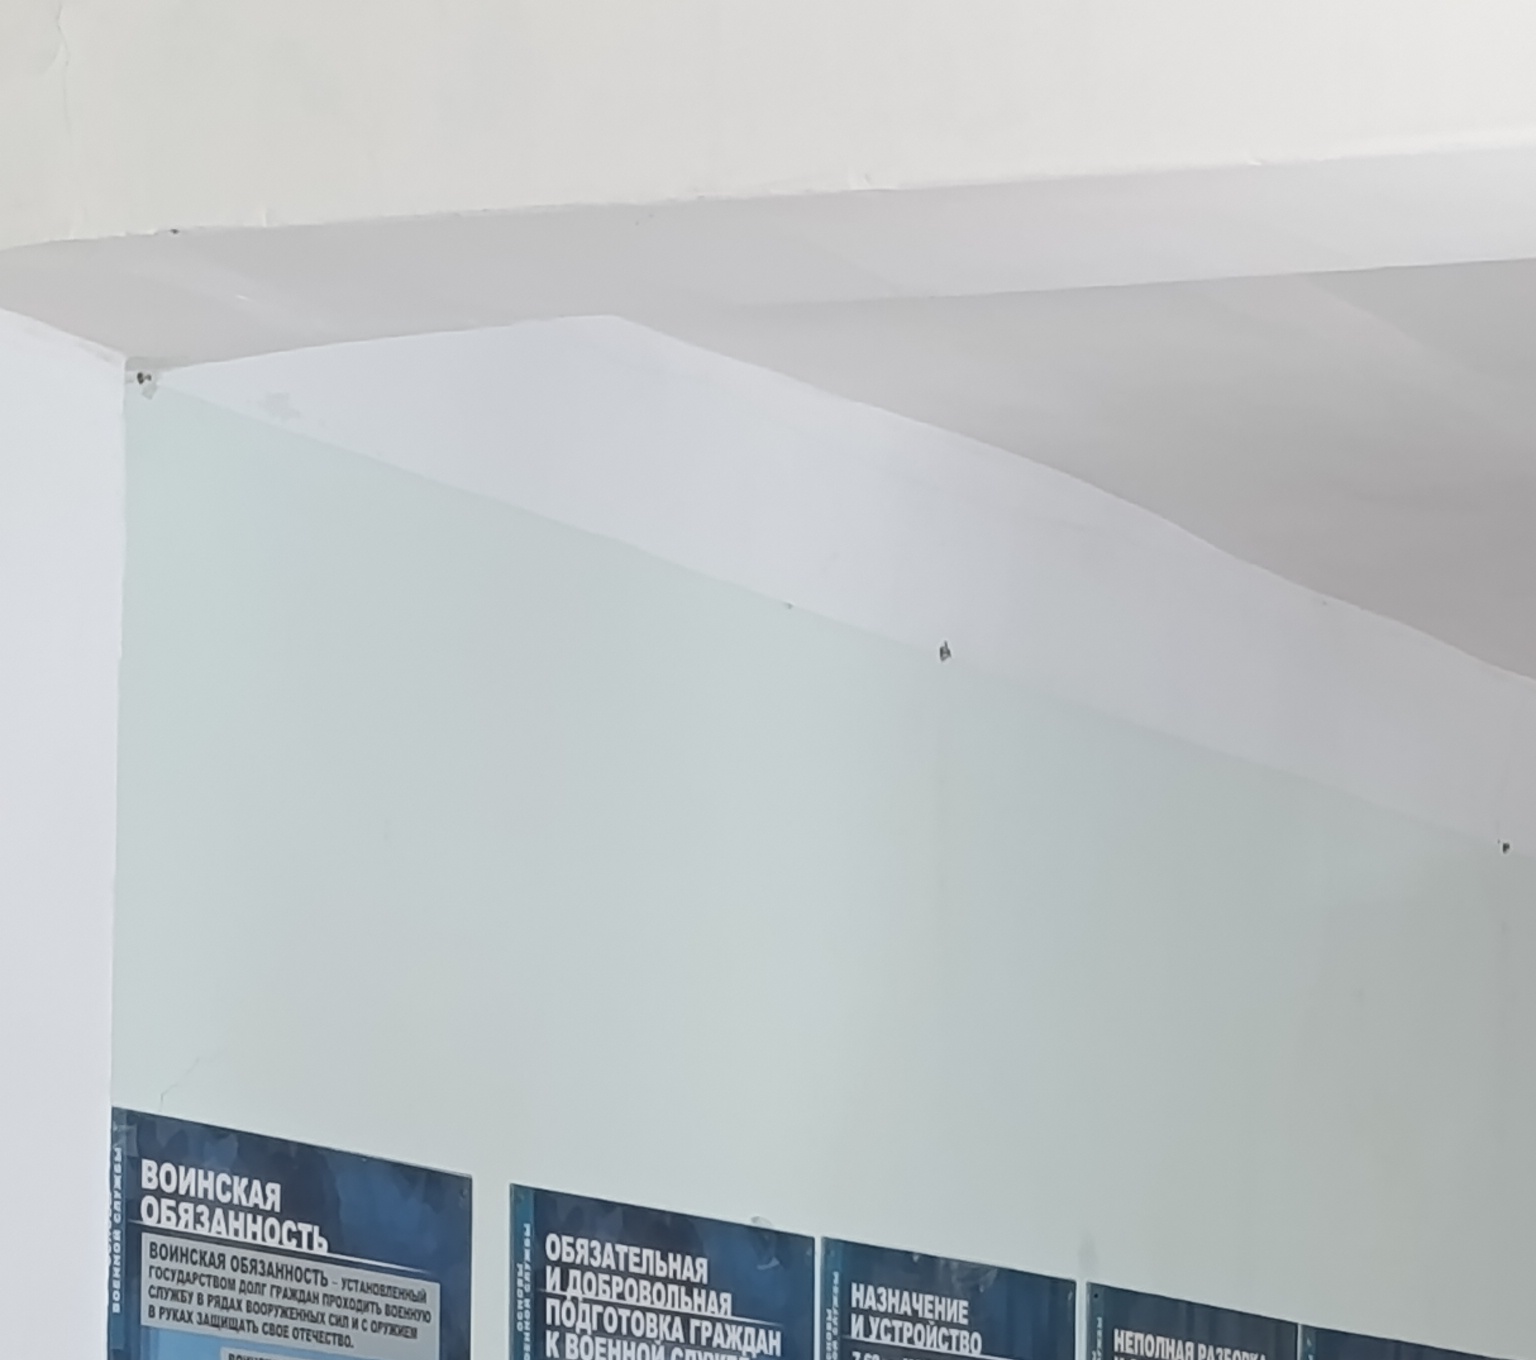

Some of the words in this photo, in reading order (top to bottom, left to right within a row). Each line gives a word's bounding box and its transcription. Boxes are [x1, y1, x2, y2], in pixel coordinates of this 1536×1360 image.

[112, 1147, 122, 1224] СЛУЖБЫ
[141, 1158, 281, 1212] ВОИНСКАЯ
[140, 1195, 329, 1254] ОБЯЗАННОСТЬ
[112, 1229, 122, 1314] ВОЕННОЙ
[149, 1241, 226, 1269] ВОИНСКАЯ
[230, 1255, 328, 1287] ОБЯЗАННОСТЬ
[341, 1278, 427, 1303] УСТАНОВЛЕННЫЙ
[523, 1222, 531, 1293] СЛУЖБЫ
[546, 1233, 708, 1284] ОБЯЗАТЕЛЬНАЯ
[148, 1265, 236, 1291] ГОСУДАРСТВОМ
[239, 1282, 267, 1295] ДОЛГ
[270, 1285, 319, 1304] ГРАЖДАН
[322, 1293, 382, 1316] ПРОХОДИТЬ
[385, 1304, 432, 1323] ВОЕННУЮ
[148, 1285, 194, 1305] СЛУЖБУ
[198, 1292, 204, 1305] В
[207, 1295, 242, 1312] РЯДАХ
[246, 1300, 325, 1325] ВООРУЖЕННЫХ
[329, 1315, 349, 1328] СИЛ
[352, 1319, 359, 1329] И
[362, 1320, 368, 1331] С
[370, 1321, 417, 1339] ОРУЖИЕМ
[516, 1262, 524, 1332] ОСНОВЫ
[546, 1265, 561, 1293] И
[566, 1268, 732, 1316] ДОБРОВОЛЬНАЯ
[851, 1282, 969, 1325] НАЗНАЧЕНИЕ
[148, 1304, 156, 1319] В
[159, 1307, 193, 1324] РУКАХ
[197, 1313, 258, 1334] ЗАЩИЩАТЬ
[262, 1323, 289, 1338] СВОЕ
[292, 1327, 354, 1348] ОТЕЧЕСТВО.
[546, 1298, 684, 1343] ПОДГОТОВКА
[691, 1319, 782, 1358] ГРАЖДАН
[546, 1330, 560, 1358] К
[851, 1313, 863, 1338] И
[869, 1315, 982, 1354] УСТРОЙСТВО
